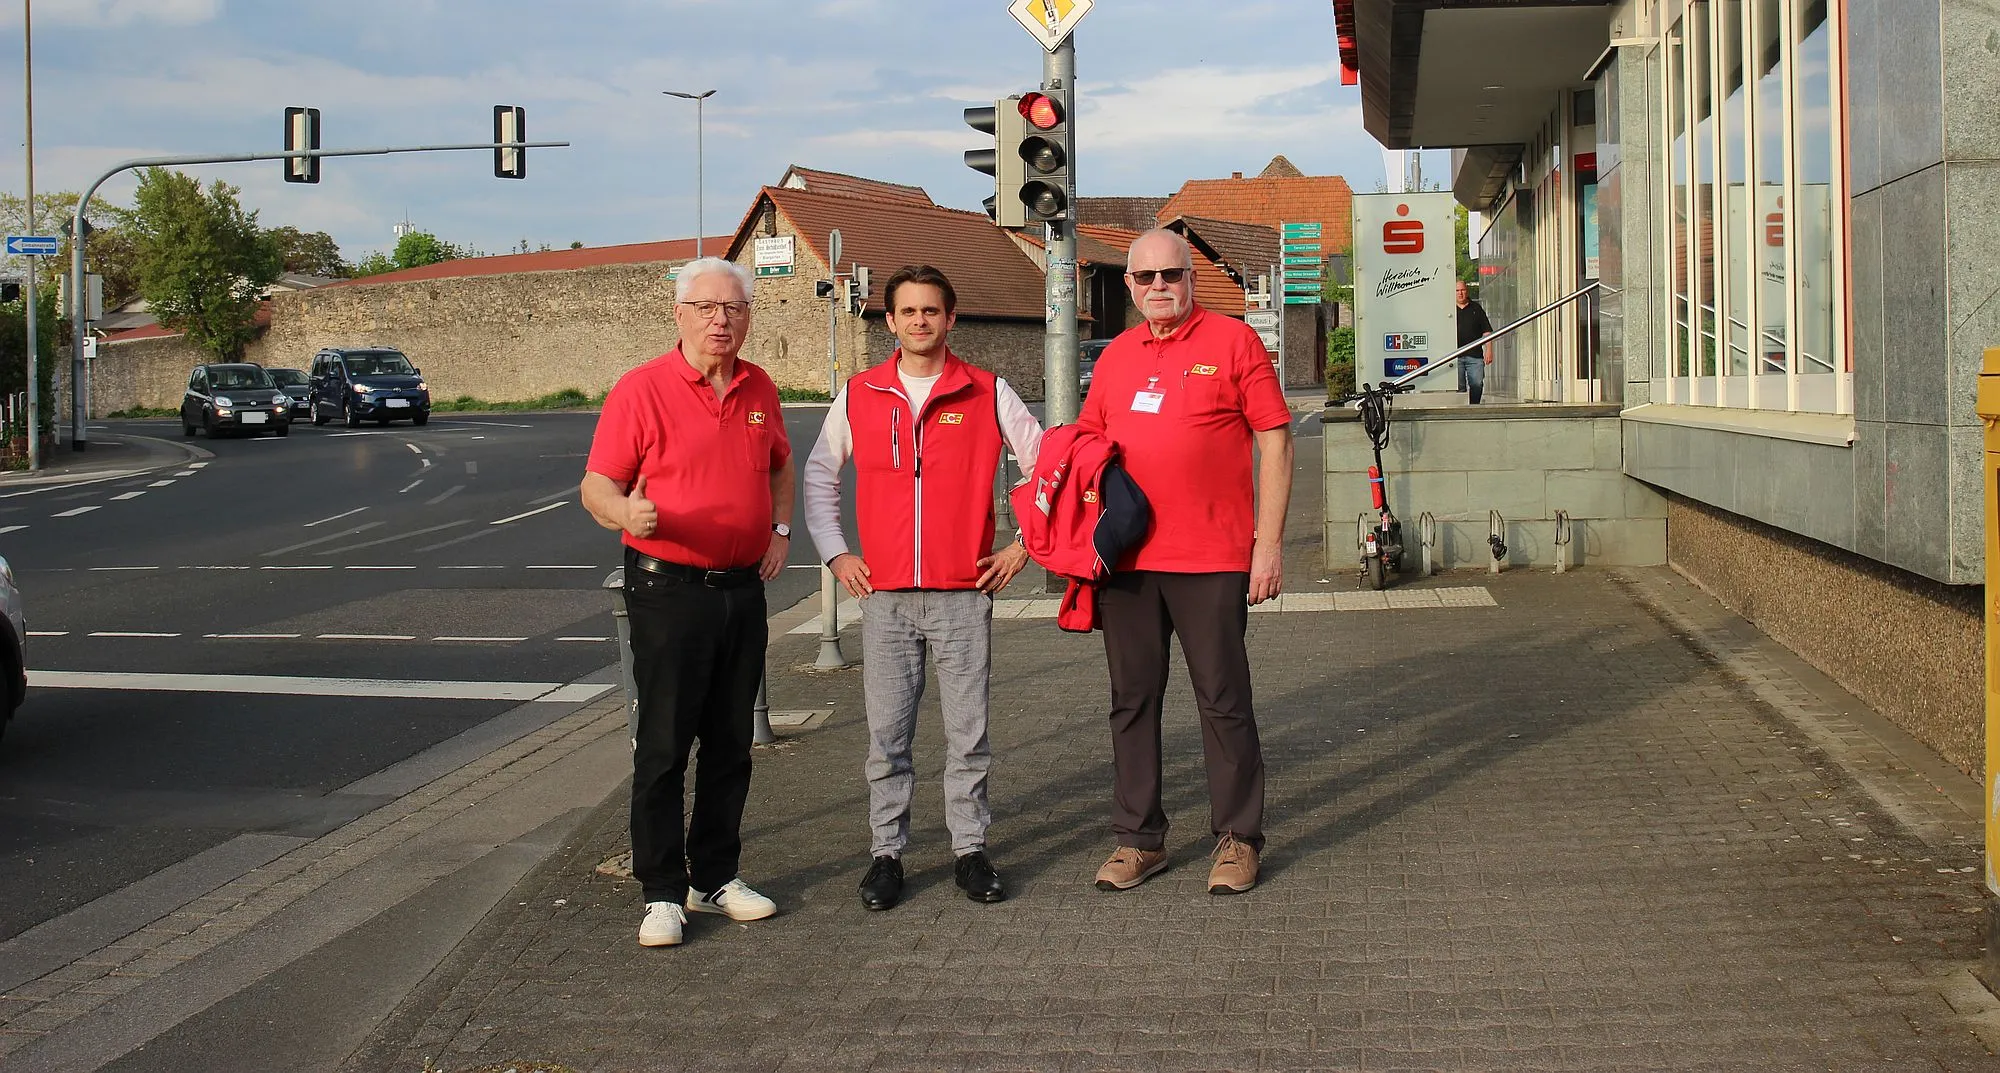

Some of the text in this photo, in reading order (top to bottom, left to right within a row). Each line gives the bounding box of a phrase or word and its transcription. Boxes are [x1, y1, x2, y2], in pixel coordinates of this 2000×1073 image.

[1382, 267, 1420, 283] Herzlich
[1376, 277, 1430, 297] Willkommen
[1192, 364, 1217, 375] ACE
[940, 413, 963, 423] ACE
